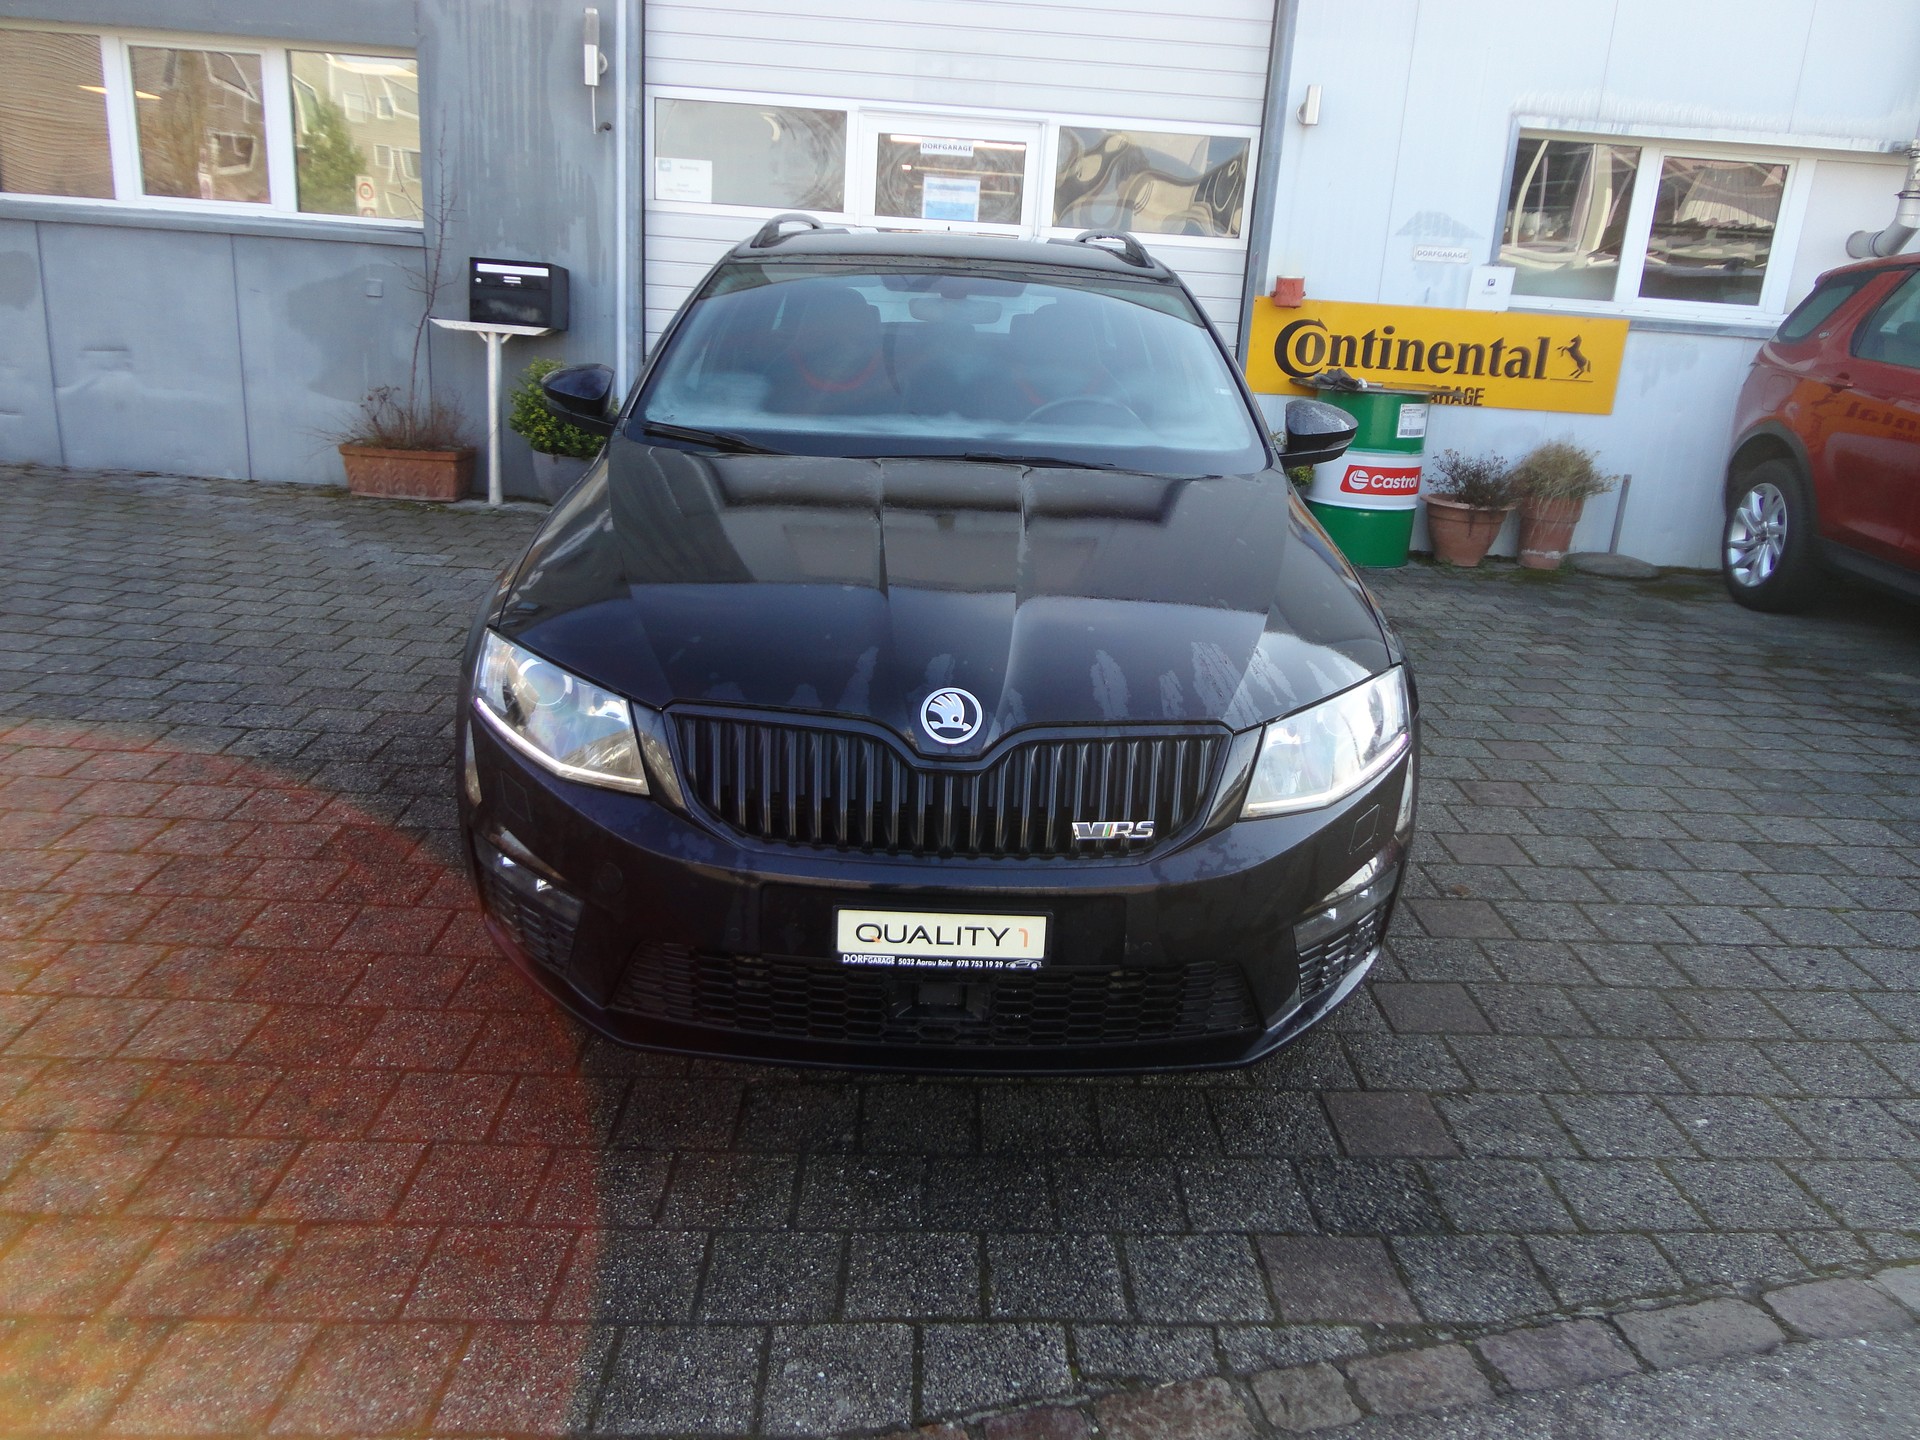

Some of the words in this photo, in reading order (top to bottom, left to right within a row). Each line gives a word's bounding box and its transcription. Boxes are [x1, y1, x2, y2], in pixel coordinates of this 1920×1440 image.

[922, 142, 973, 152] DORFGARAGE
[1416, 249, 1469, 260] DORFGARAGE
[1273, 317, 1552, 380] Continental
[1370, 474, 1419, 489] Castrol
[855, 922, 1011, 947] QUALITY
[1018, 927, 1029, 948] 1
[842, 953, 896, 965] DORFGARAGE
[898, 957, 915, 966] 5032
[916, 958, 937, 967] Aarau
[937, 959, 953, 967] Rohr
[956, 959, 970, 967] 078
[970, 960, 984, 968] 753
[985, 960, 994, 968] 19
[994, 960, 1004, 968] 29
